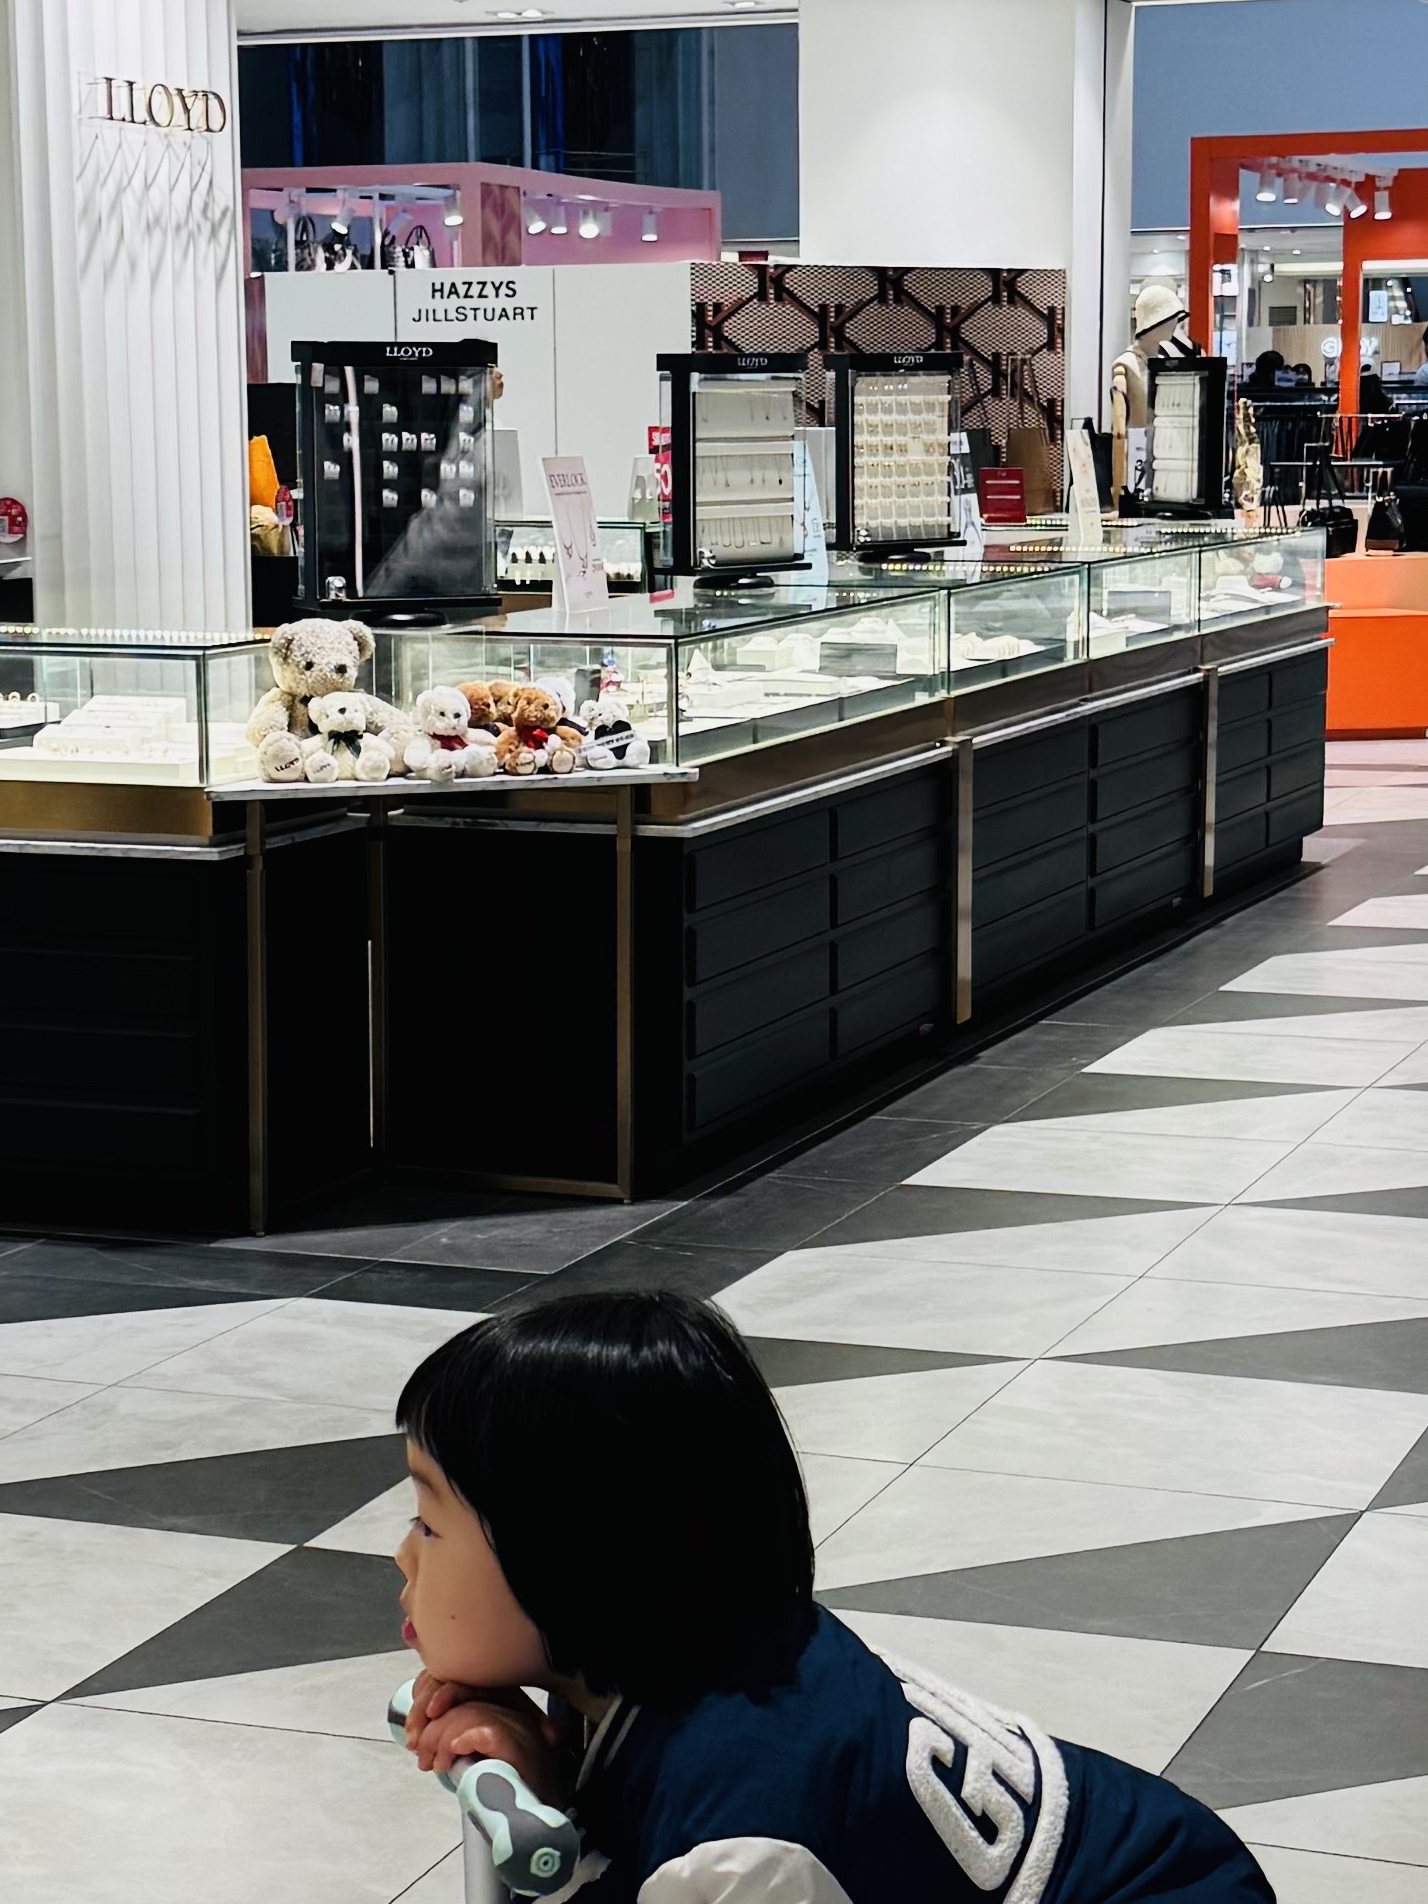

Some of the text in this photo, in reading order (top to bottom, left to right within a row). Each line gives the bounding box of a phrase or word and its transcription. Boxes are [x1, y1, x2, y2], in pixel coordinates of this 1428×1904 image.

[102, 76, 228, 133] LLOYD
[431, 280, 518, 300] HAZZYS
[386, 346, 434, 358] LLOYD
